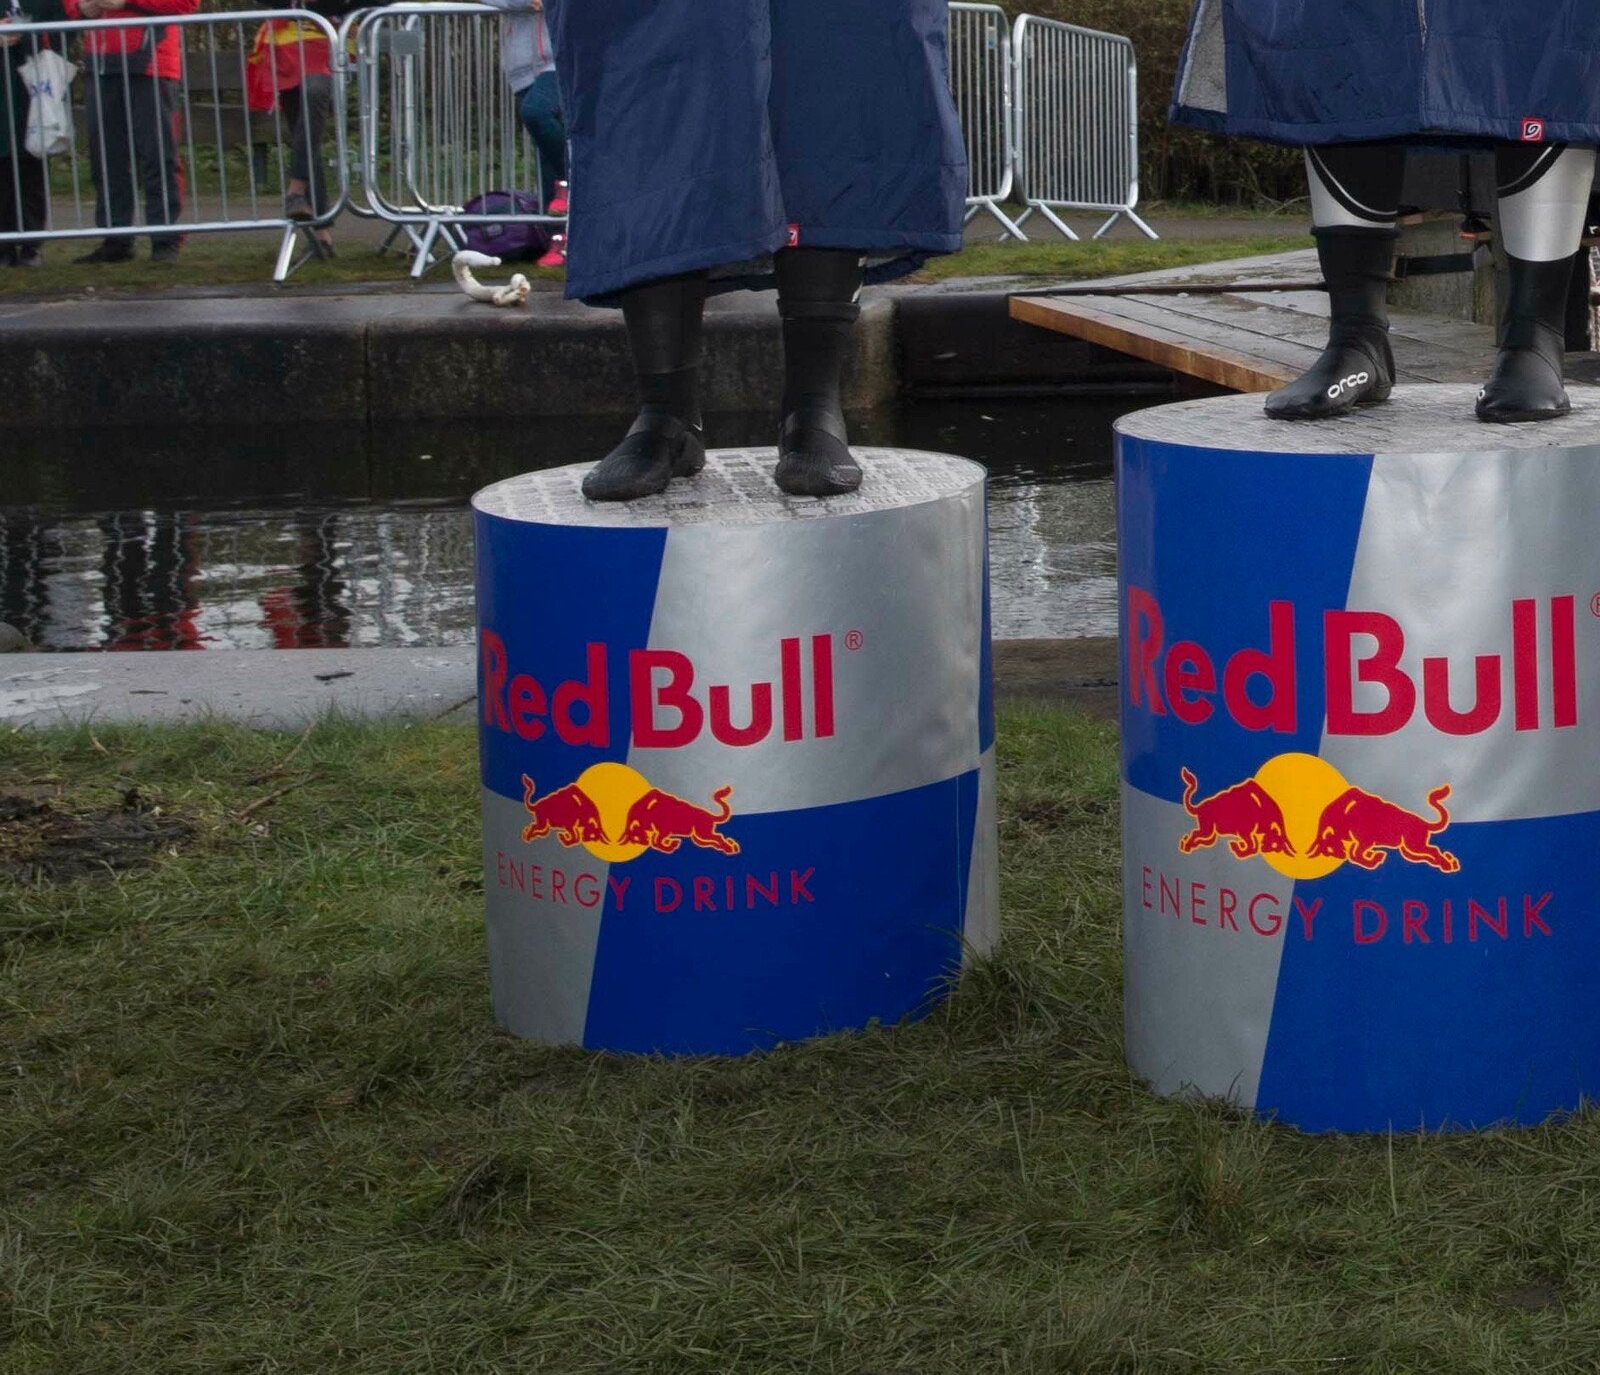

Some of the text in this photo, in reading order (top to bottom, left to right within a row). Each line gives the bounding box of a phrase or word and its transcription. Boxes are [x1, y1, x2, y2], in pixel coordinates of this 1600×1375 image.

[481, 629, 609, 748] Red
[1127, 585, 1297, 734] Red
[497, 851, 815, 913] ENERGY DRINK
[1142, 865, 1554, 944] ENERGY DRINK
